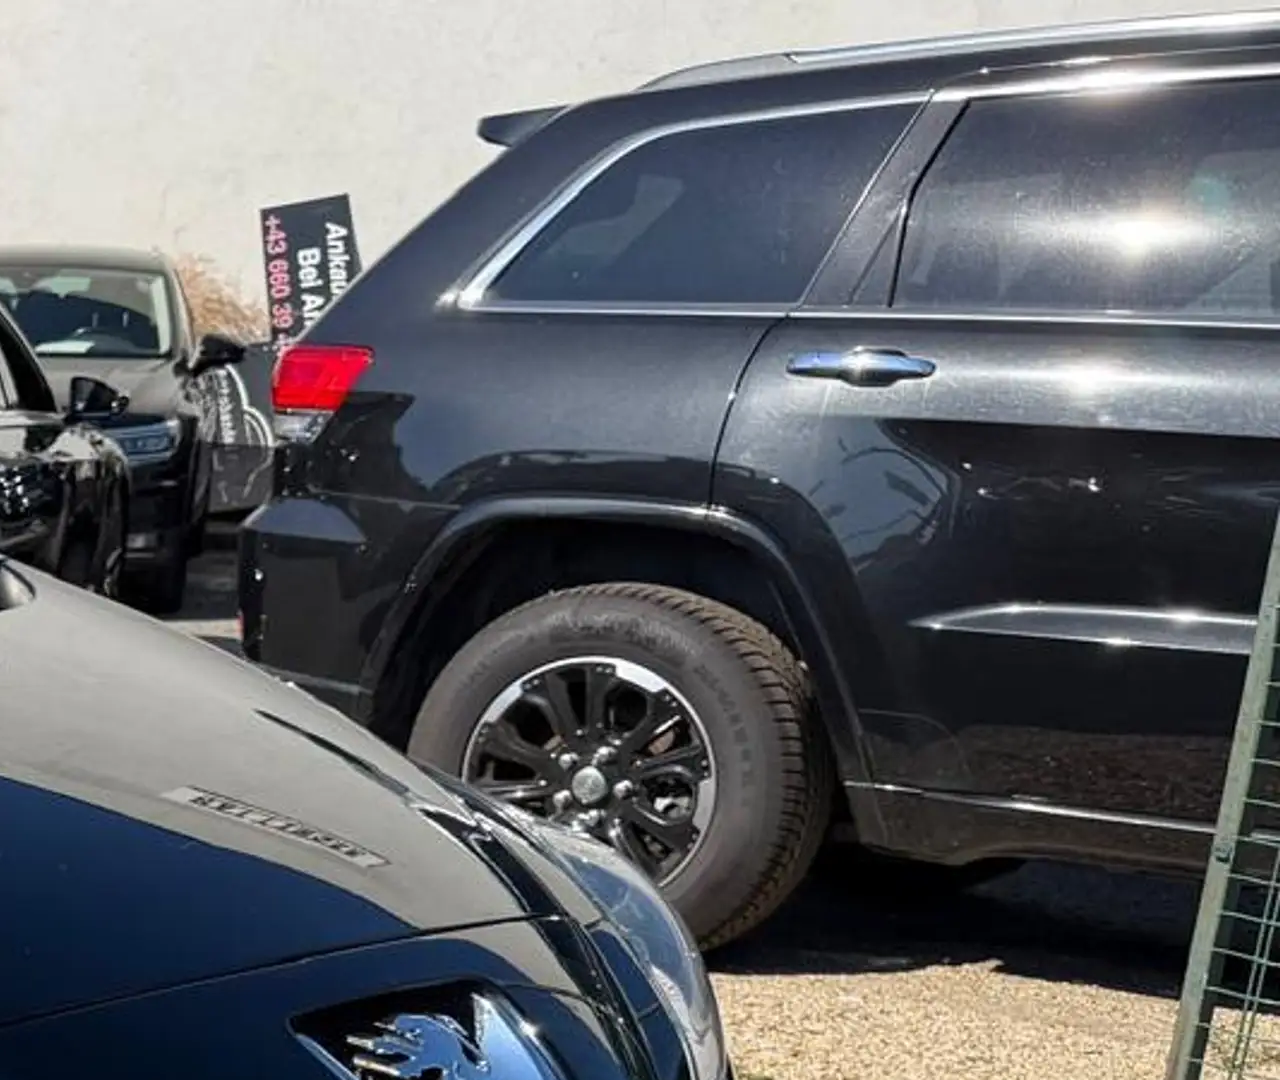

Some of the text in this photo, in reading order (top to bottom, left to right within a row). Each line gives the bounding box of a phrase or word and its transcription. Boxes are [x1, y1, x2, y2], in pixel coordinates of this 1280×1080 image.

[265, 214, 287, 255] +43
[268, 258, 291, 299] 660
[325, 221, 351, 298] Ankau
[271, 302, 294, 329] 39
